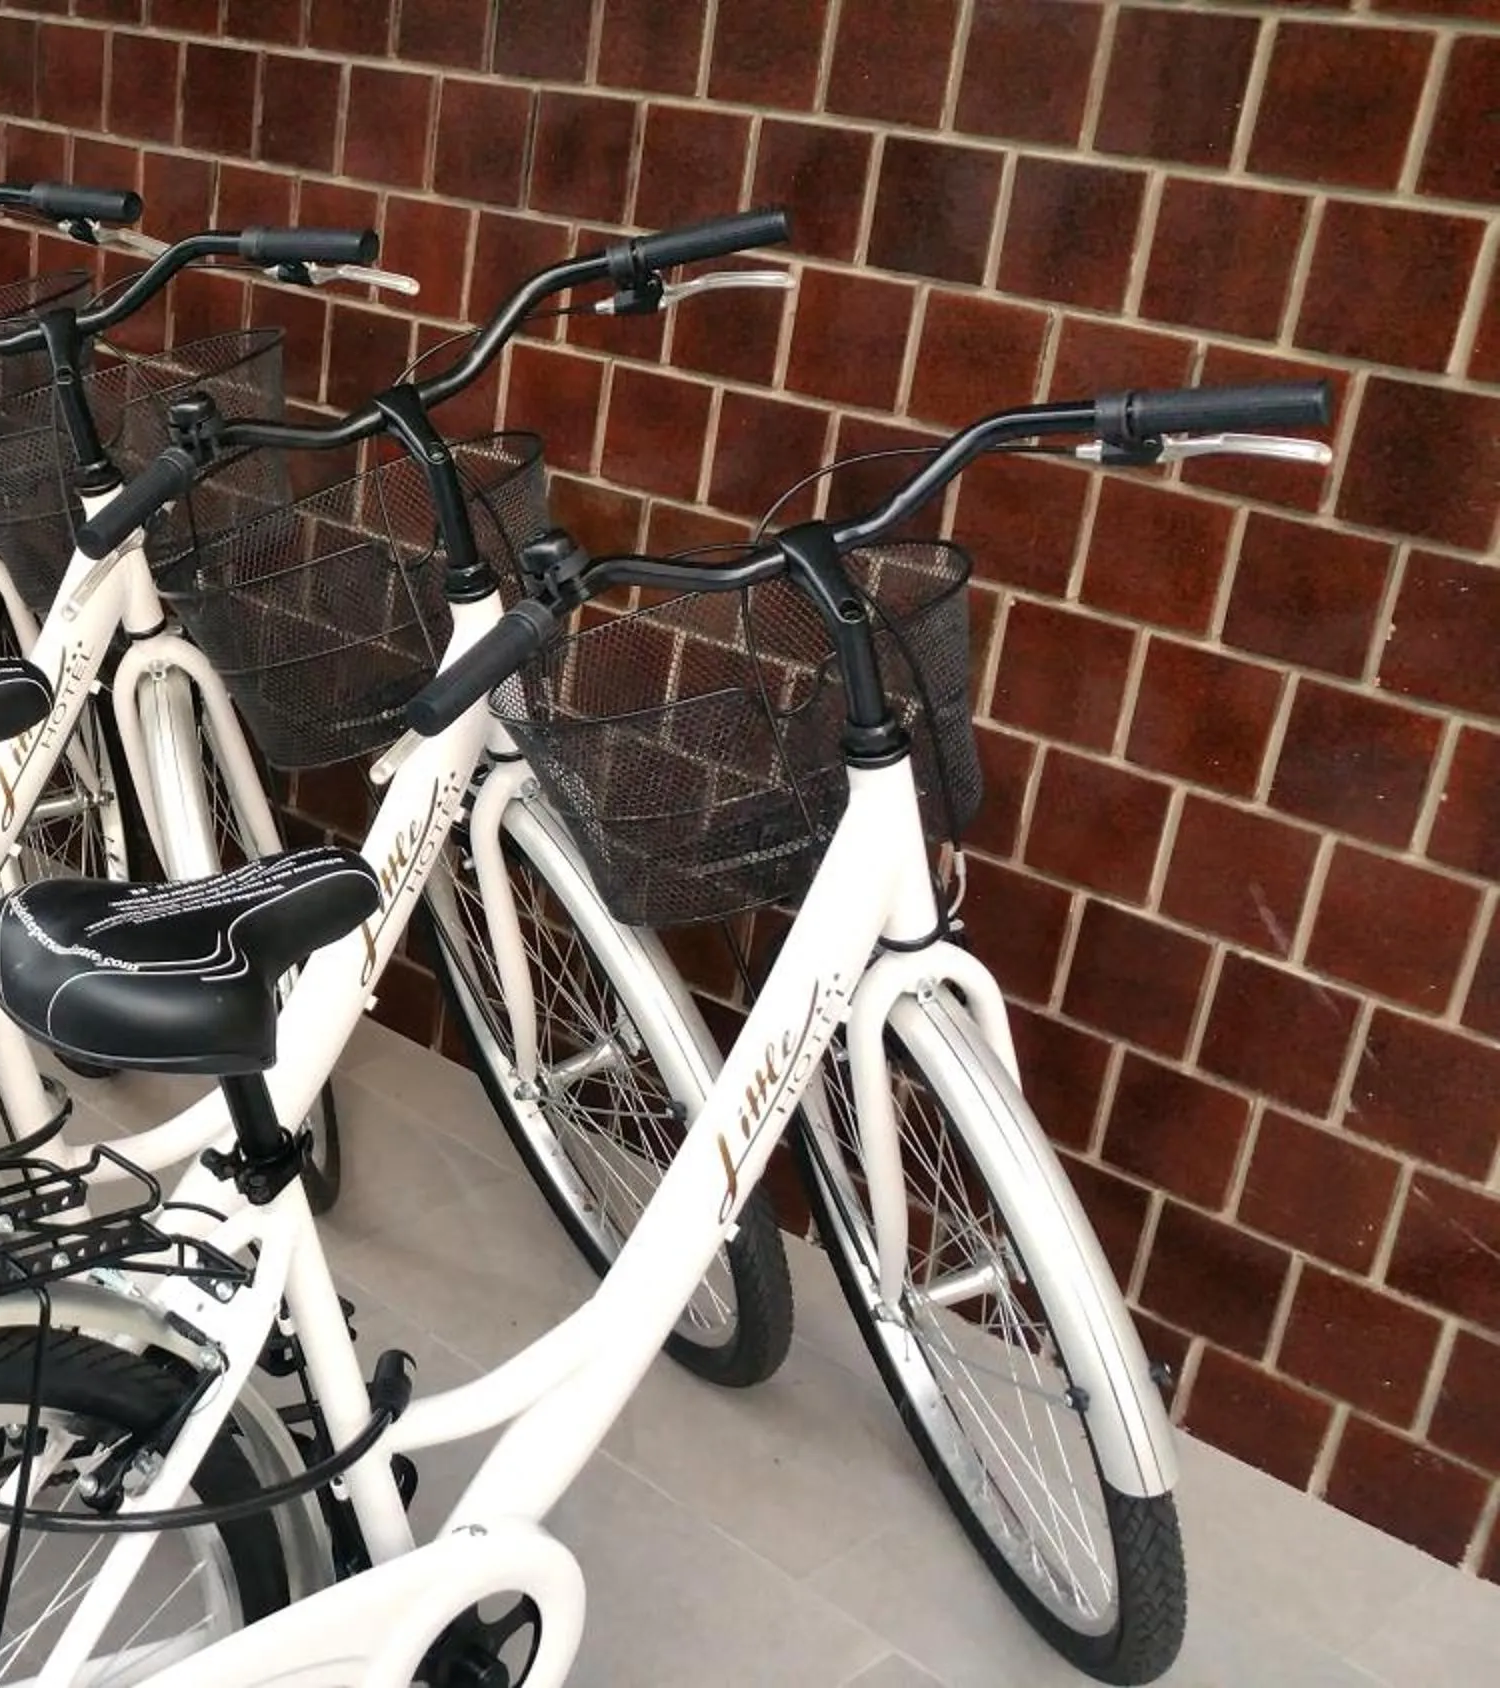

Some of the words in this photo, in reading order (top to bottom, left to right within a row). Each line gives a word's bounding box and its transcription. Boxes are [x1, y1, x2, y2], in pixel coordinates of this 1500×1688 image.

[41, 650, 93, 749] HOTEL
[405, 782, 465, 894] HOTEL
[717, 976, 819, 1225] Little
[775, 981, 850, 1116] HOTEL
